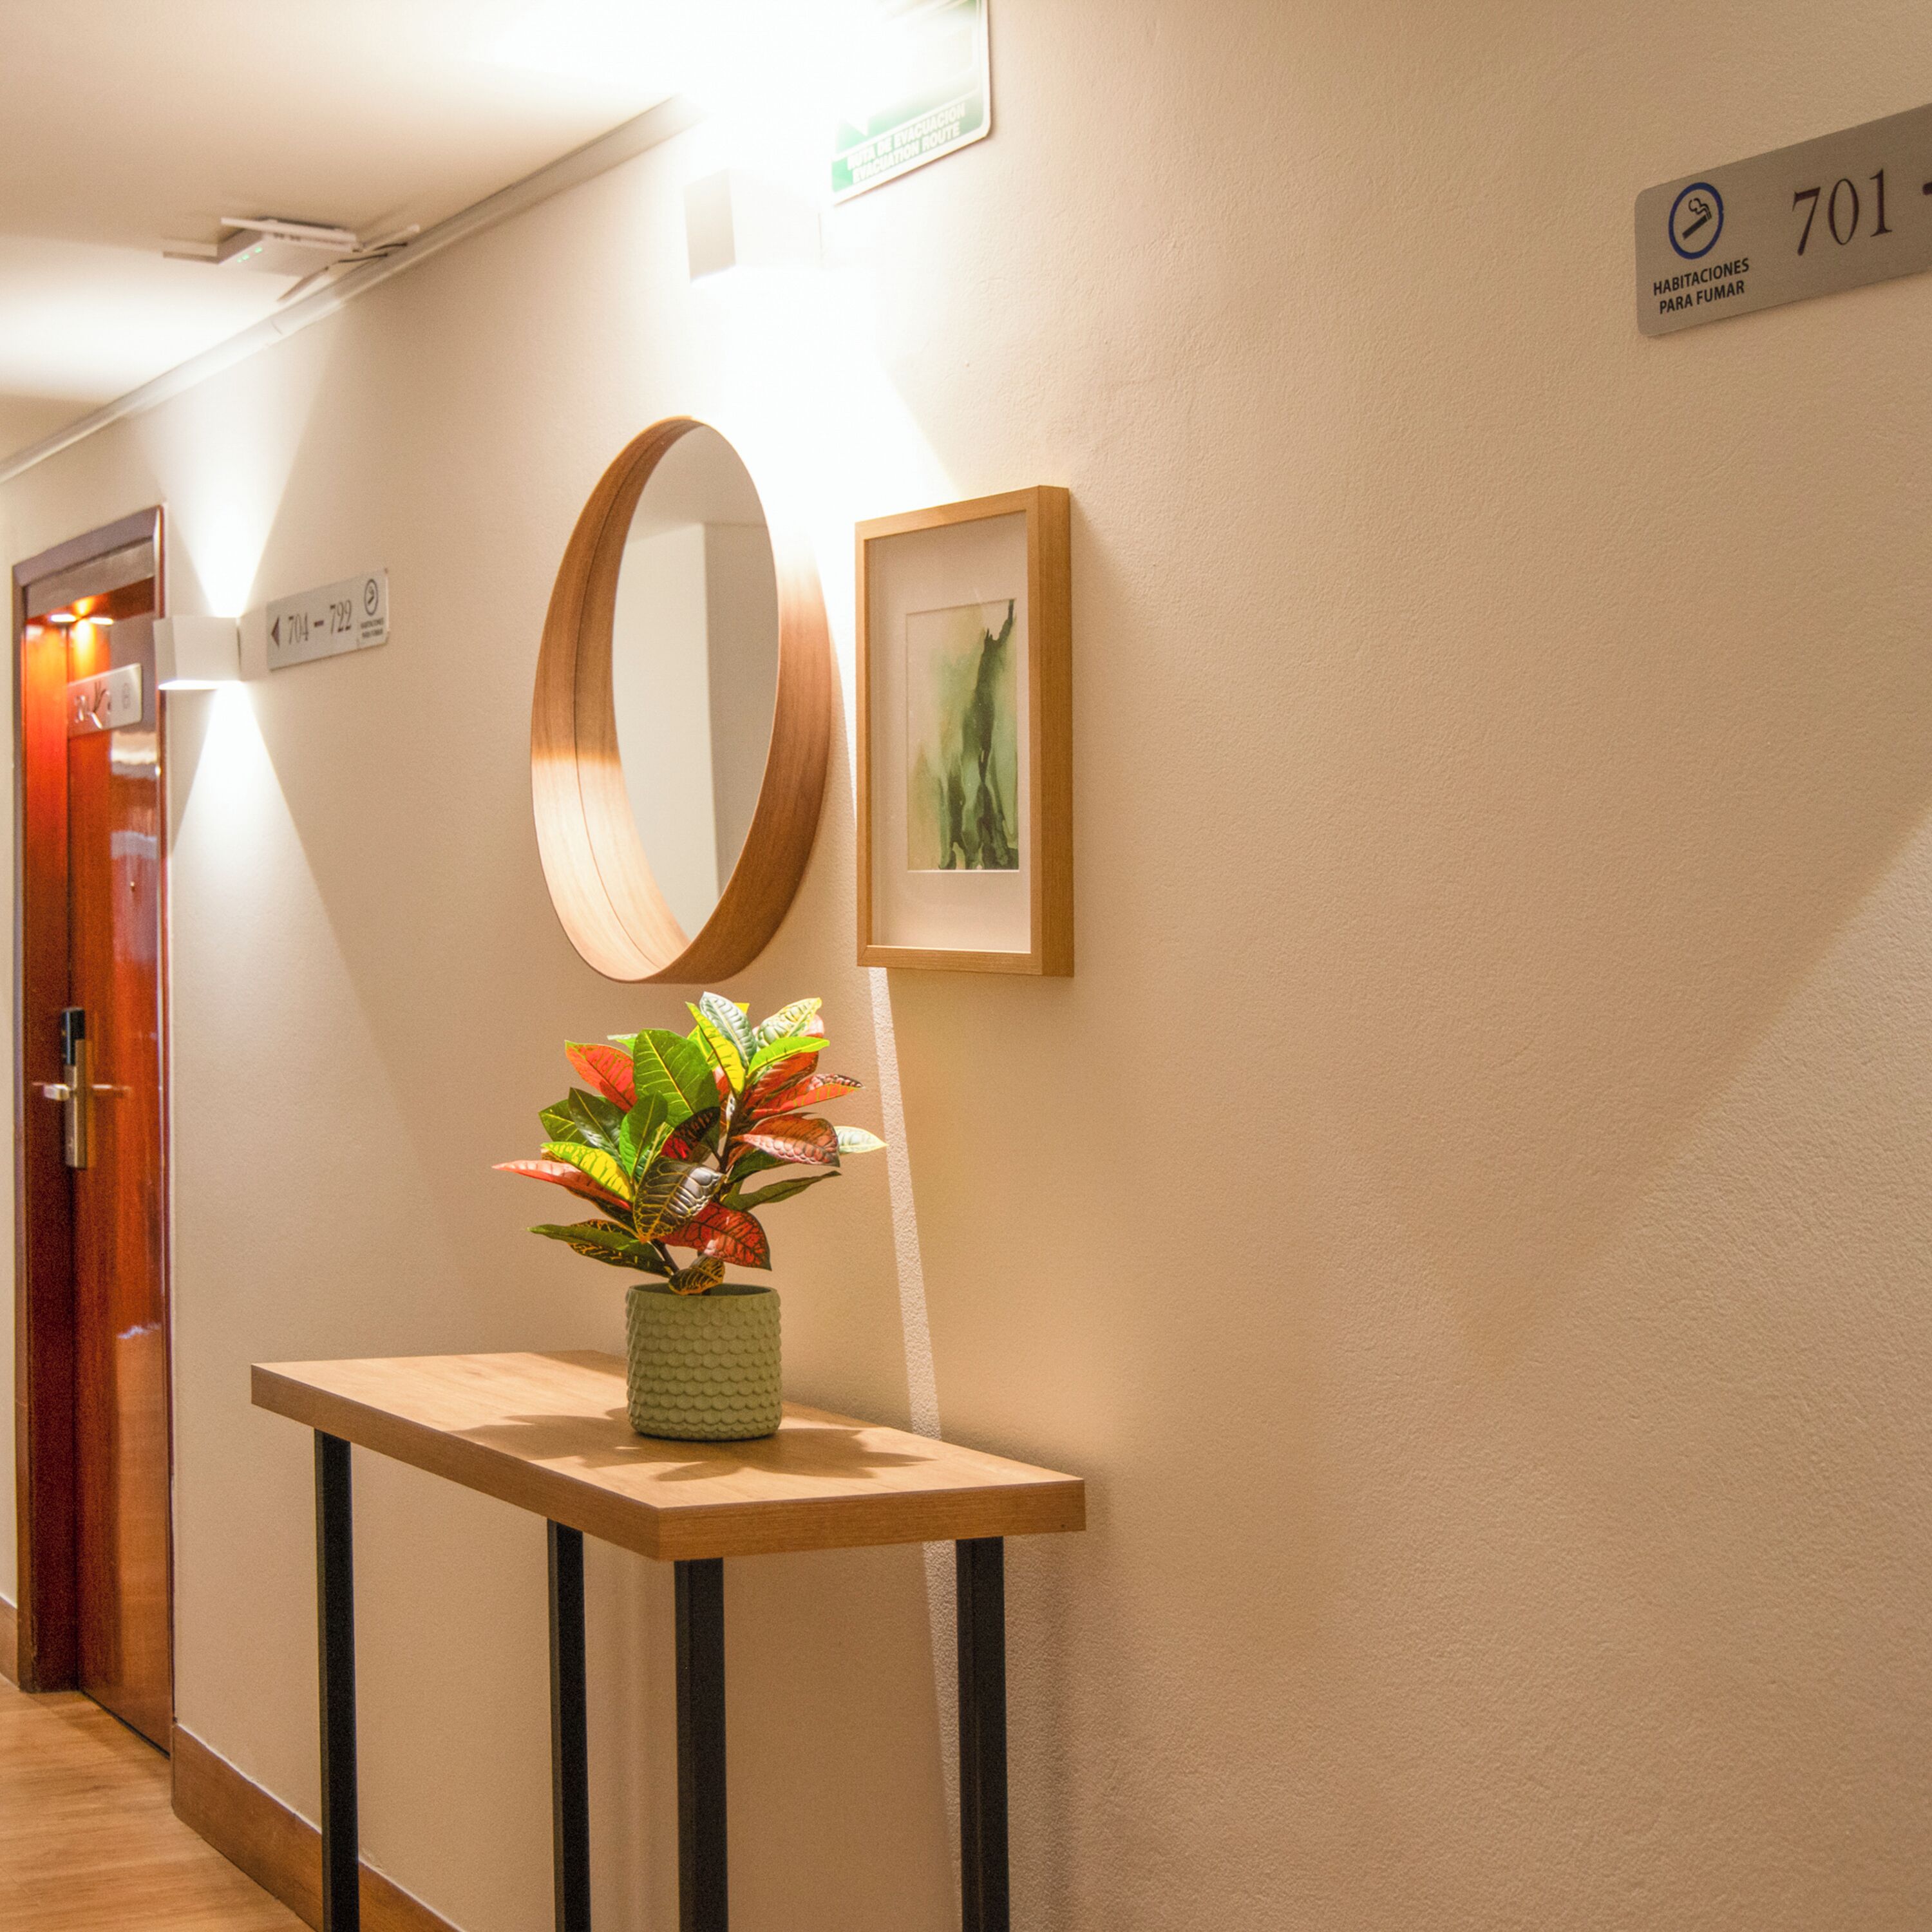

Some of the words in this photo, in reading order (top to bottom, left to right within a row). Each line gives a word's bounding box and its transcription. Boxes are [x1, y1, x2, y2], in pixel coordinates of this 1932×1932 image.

[848, 146, 876, 170] RUTA
[877, 137, 893, 156] DE
[853, 141, 920, 184] EVACUATION
[922, 122, 960, 151] ROUTE
[1792, 167, 1892, 256] 701
[1653, 258, 1750, 296] HABITACIONES
[1659, 293, 1693, 314] PARA
[1696, 280, 1745, 305] FUMAR
[288, 612, 309, 645] 704
[330, 600, 352, 634] 722
